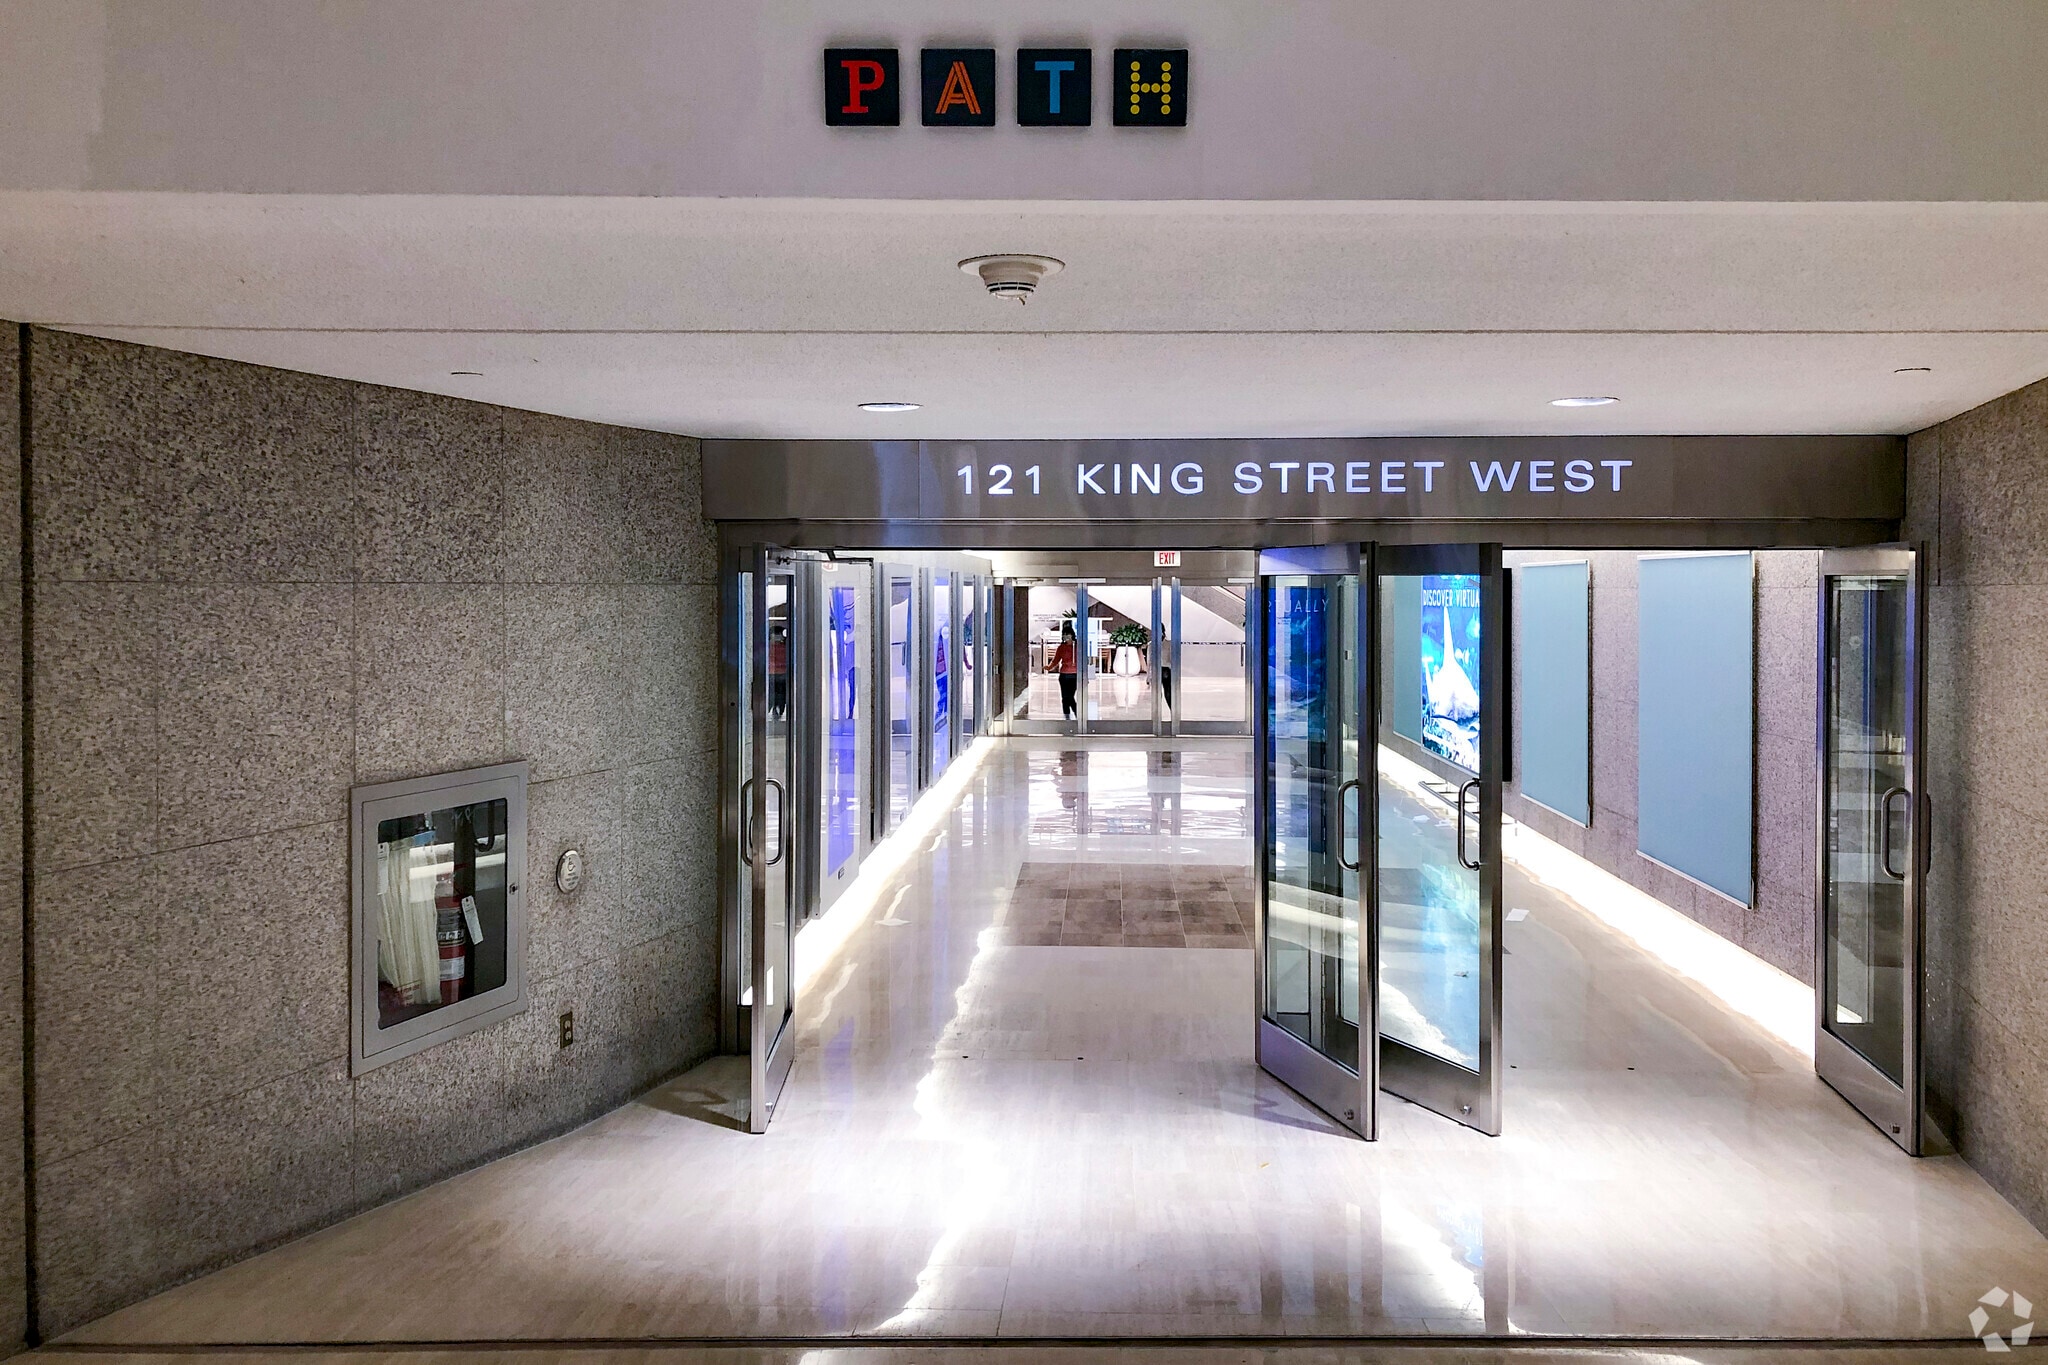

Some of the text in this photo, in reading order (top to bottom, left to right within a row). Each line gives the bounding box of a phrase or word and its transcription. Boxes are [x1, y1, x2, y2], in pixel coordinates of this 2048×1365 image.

[840, 60, 1171, 115] PATH
[956, 459, 1634, 496] 121 KING STREET WEST
[1159, 552, 1176, 565] EXIT
[1423, 588, 1453, 607] DISCOVER
